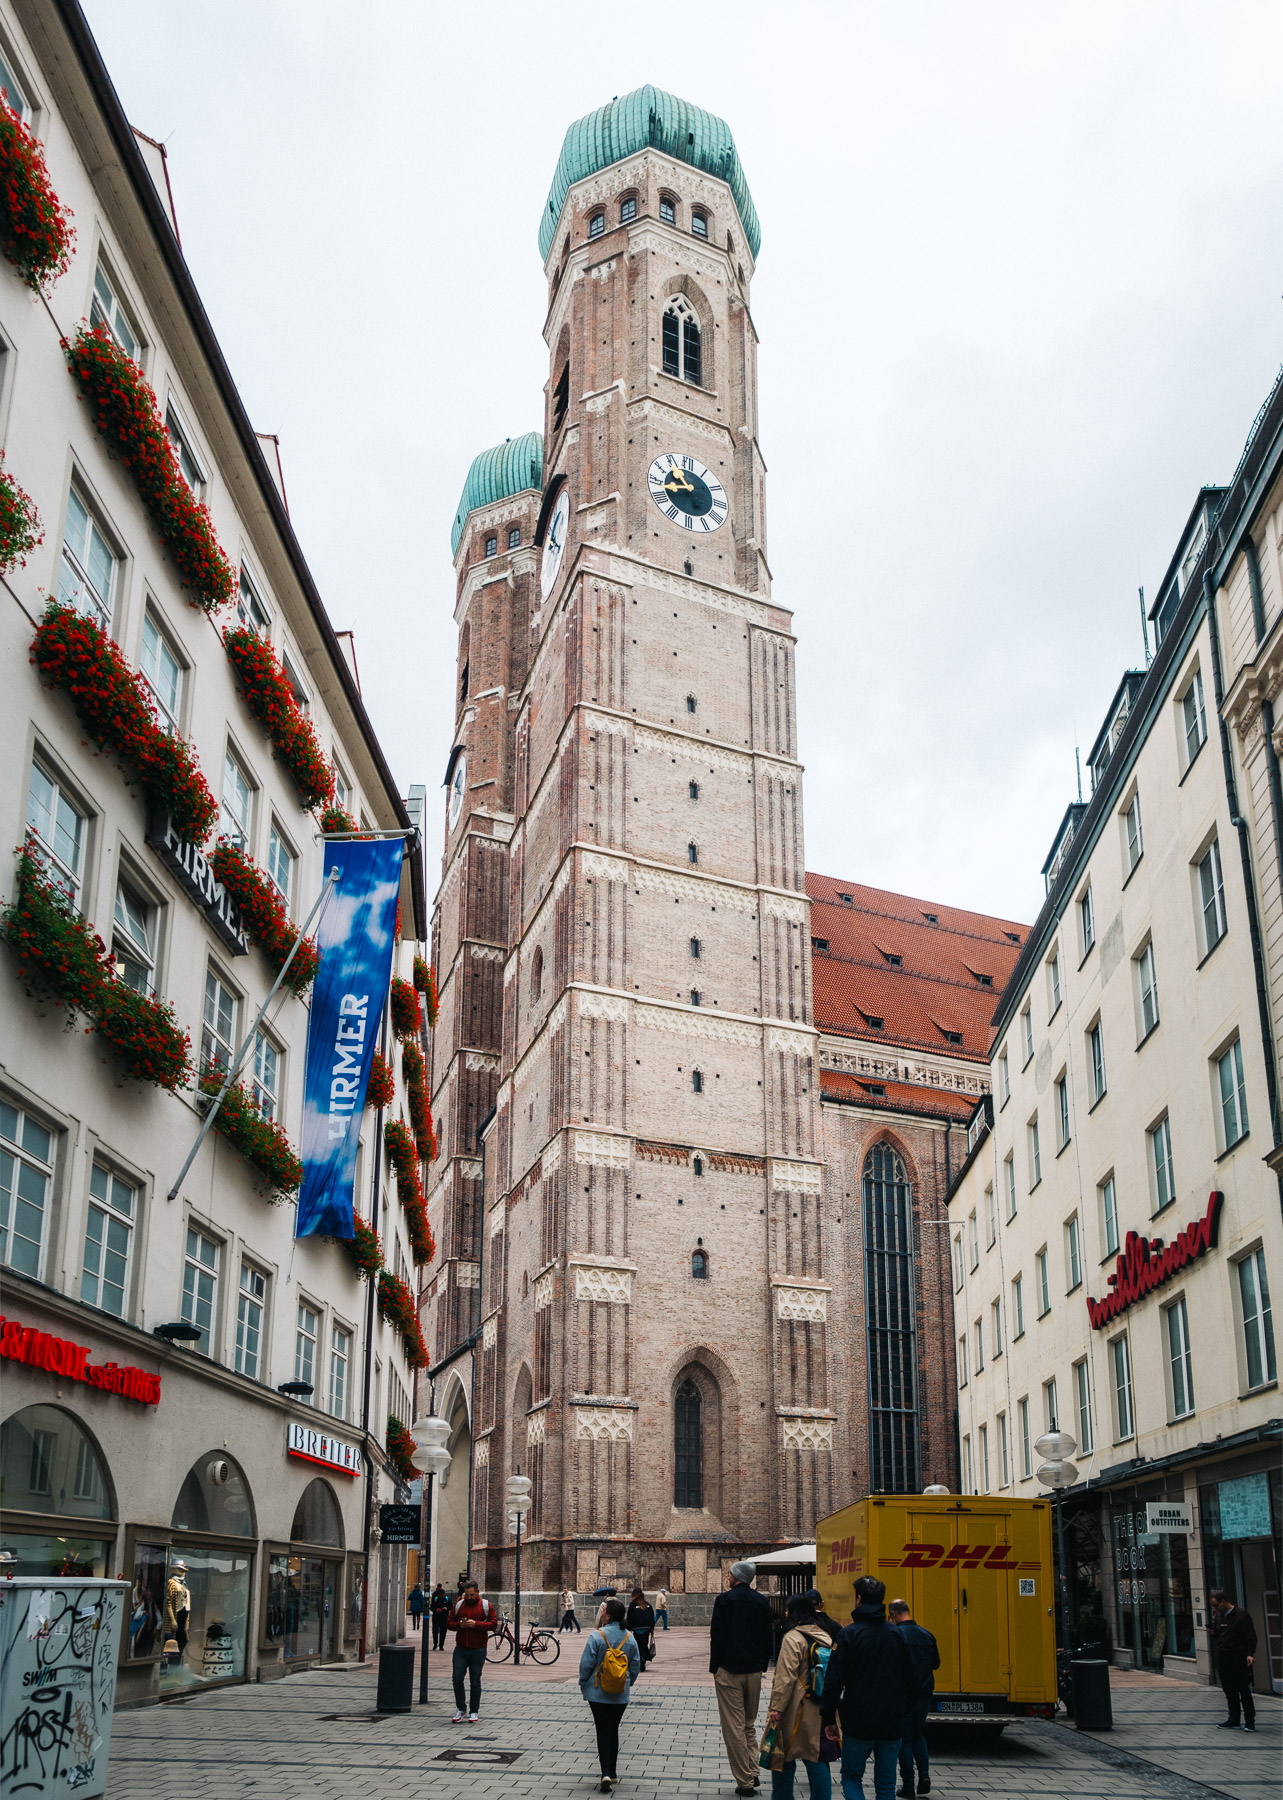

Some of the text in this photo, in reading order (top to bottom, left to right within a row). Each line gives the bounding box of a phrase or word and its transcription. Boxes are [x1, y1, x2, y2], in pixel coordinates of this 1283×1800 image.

[713, 499, 727, 510] III
[328, 994, 369, 1141] HIRMER
[290, 1423, 361, 1472] BREITER
[1114, 1512, 1134, 1538] THE
[1151, 1518, 1190, 1526] OUTFITTERS
[1159, 1509, 1181, 1517] URBAN
[831, 1535, 856, 1575] DHL
[900, 1543, 1019, 1570] DHL
[1116, 1545, 1147, 1570] BOOK
[966, 1703, 983, 1712] 1384
